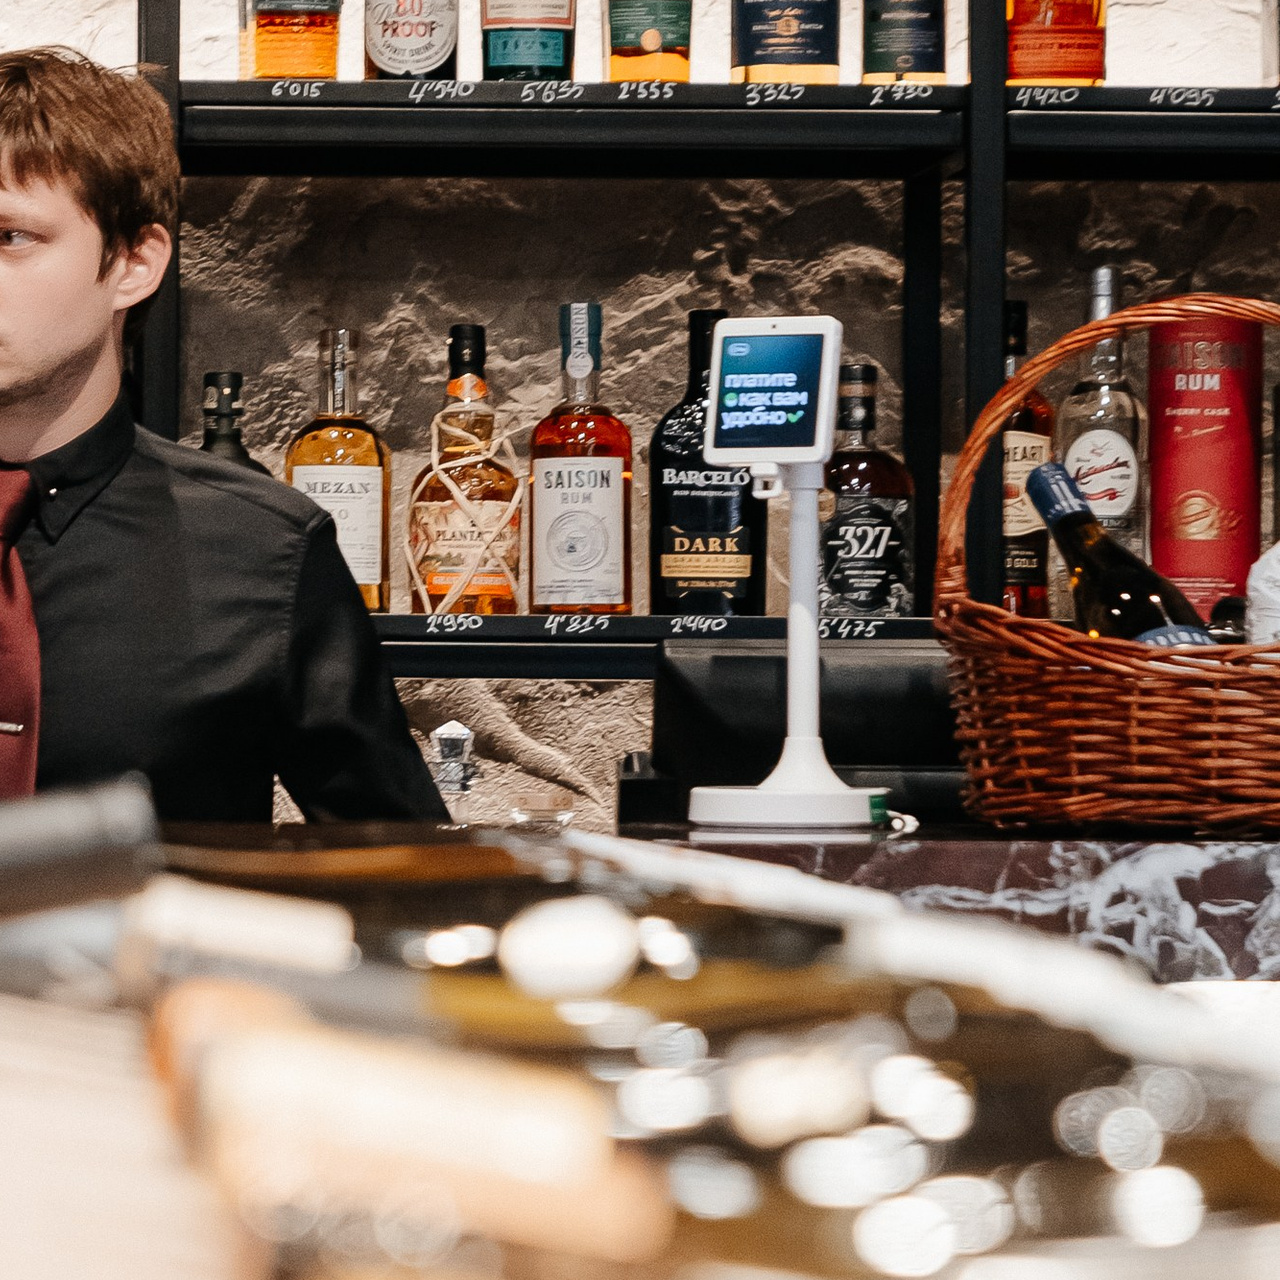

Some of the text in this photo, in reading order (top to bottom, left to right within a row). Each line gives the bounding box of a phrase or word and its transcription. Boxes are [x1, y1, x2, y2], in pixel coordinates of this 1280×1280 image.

[381, 20, 437, 38] PROOF
[271, 81, 326, 97] 6'015
[408, 81, 476, 103] 4'540
[618, 80, 677, 99] 2'555
[745, 83, 806, 105] 3'325
[1149, 87, 1220, 106] 4'095
[724, 373, 798, 388] платите
[1175, 373, 1221, 391] RUM
[738, 391, 809, 407] как вам
[721, 406, 788, 430] удобно
[543, 469, 612, 489] SAISON
[662, 467, 751, 488] BARCELÓ
[560, 491, 593, 504] RUM
[673, 537, 740, 553] DARK
[837, 525, 893, 559] 327
[425, 613, 484, 634] 2'950
[670, 615, 728, 634] 2'440
[817, 618, 886, 638] 5'475
